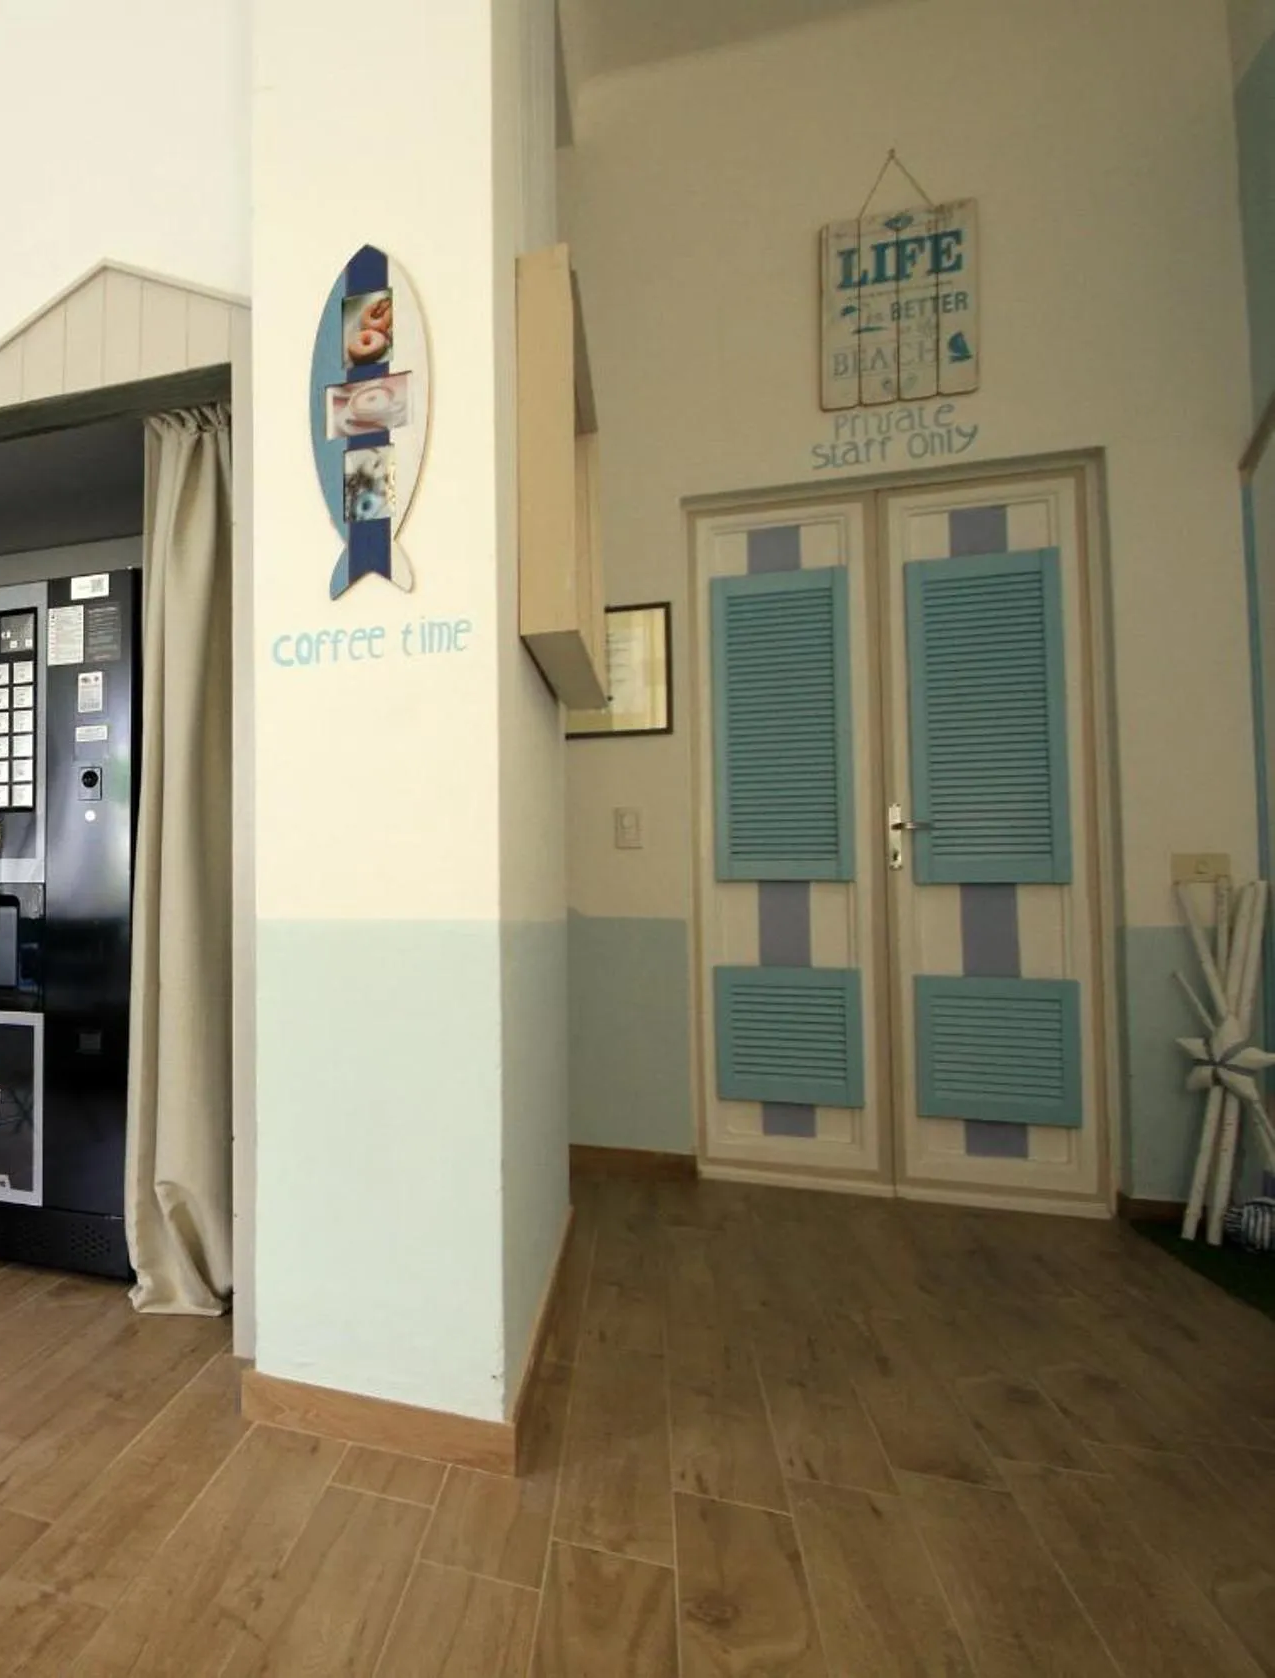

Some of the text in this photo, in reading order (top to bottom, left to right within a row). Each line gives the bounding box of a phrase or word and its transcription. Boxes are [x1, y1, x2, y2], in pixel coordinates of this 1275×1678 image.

[836, 228, 963, 290] LIFE
[891, 291, 968, 322] BETTER
[906, 424, 978, 459] Only
[271, 616, 473, 667] coffee time
